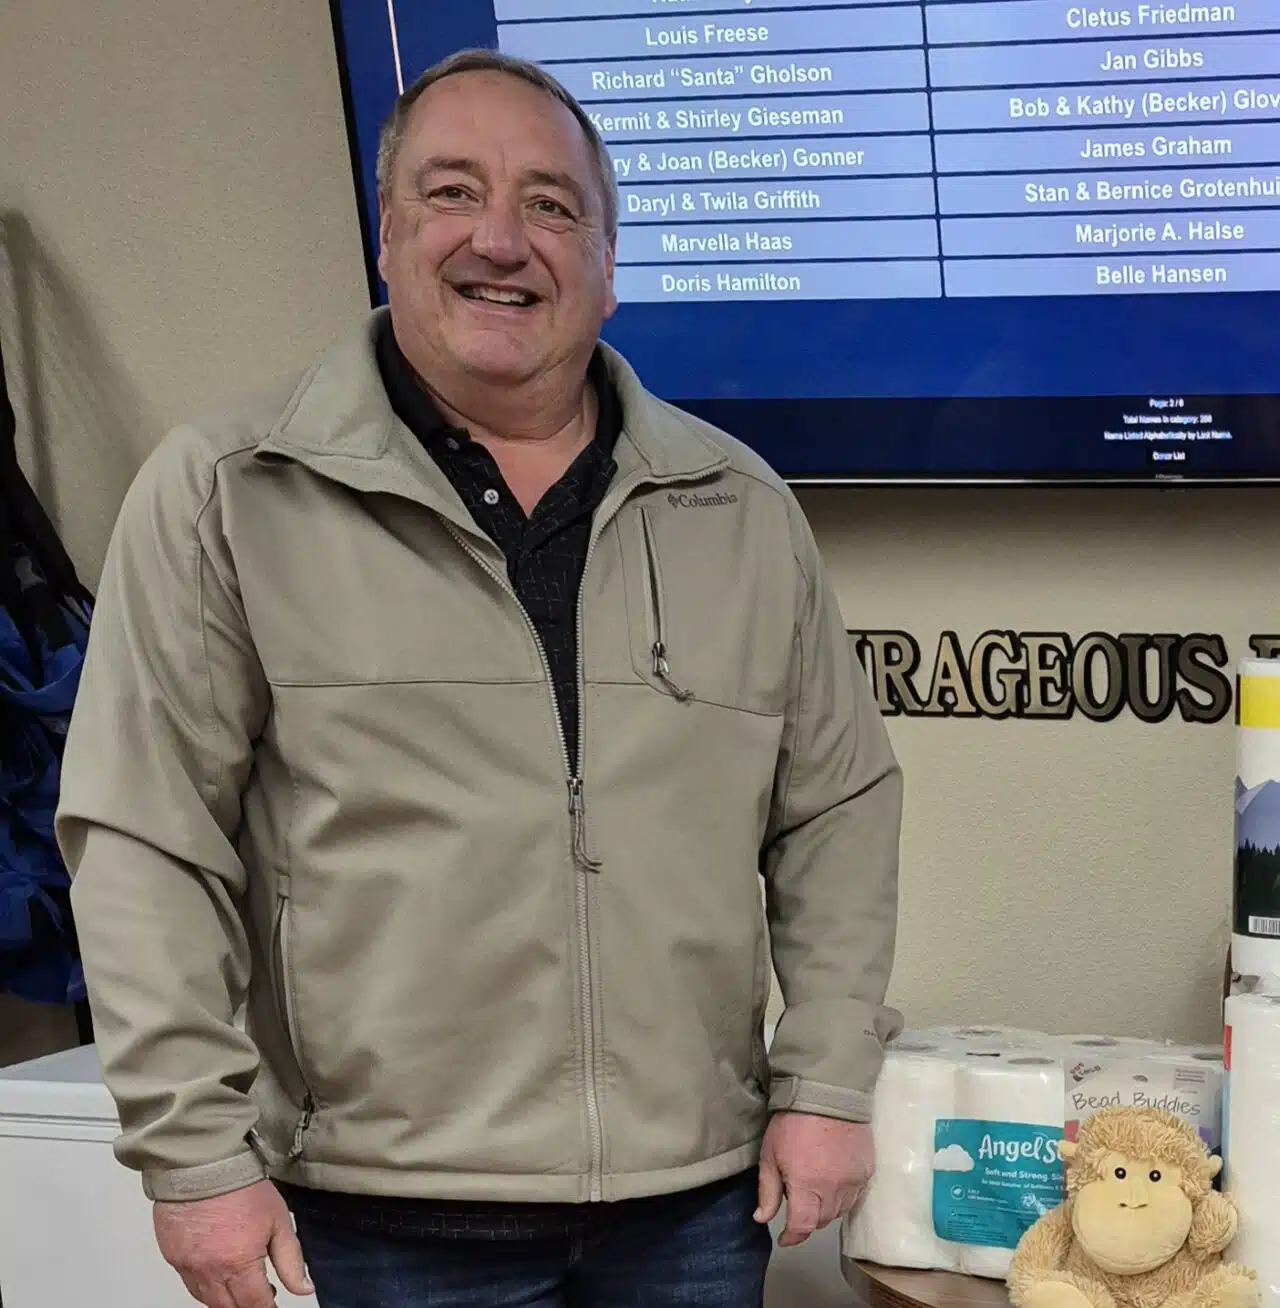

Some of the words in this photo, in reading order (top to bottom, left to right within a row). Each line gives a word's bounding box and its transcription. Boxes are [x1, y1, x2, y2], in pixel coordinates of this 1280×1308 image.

[1066, 7, 1132, 28] Cletus
[1138, 2, 1235, 25] Friedman
[645, 25, 699, 46] Louis
[703, 24, 769, 44] Freese
[1100, 50, 1137, 71] Jan
[1143, 47, 1204, 69] Gibbs
[591, 68, 666, 90] Richard
[750, 63, 832, 84] Gholson
[1009, 97, 1050, 118] Bob
[1056, 96, 1071, 116] &
[1077, 94, 1135, 119] Kathy
[1141, 90, 1227, 118] (Becker)
[588, 111, 652, 132] Kermit
[656, 110, 671, 129] &
[675, 109, 742, 132] Shirley
[747, 107, 844, 127] Gieseman
[1080, 139, 1146, 158] James
[1151, 135, 1232, 156] Graham
[613, 158, 632, 177] ry
[637, 152, 652, 172] &
[656, 152, 703, 171] Joan
[708, 148, 788, 174] (Becker)
[793, 147, 865, 167] Gonner
[626, 193, 676, 217] Daryl
[681, 192, 696, 211] &
[699, 191, 749, 211] Twila
[753, 189, 821, 210] Griffith
[1024, 183, 1070, 203] Stan
[1075, 181, 1091, 201] &
[1096, 179, 1173, 200] Bernice
[661, 233, 740, 252] Marvella
[745, 231, 793, 250] Haas
[1075, 222, 1157, 248] Marjorie
[1161, 221, 1182, 241] A.
[1188, 220, 1245, 241] Halse
[661, 274, 712, 292] Doris
[716, 272, 801, 292] Hamilton
[1096, 265, 1146, 285] Belle
[1151, 264, 1227, 283] Hansen
[679, 492, 738, 508] Columbia
[847, 629, 1233, 724] RAGEOUS
[1072, 1091, 1121, 1110] Bead
[1132, 1092, 1201, 1116] Buddies
[978, 1133, 1043, 1162] Angel
